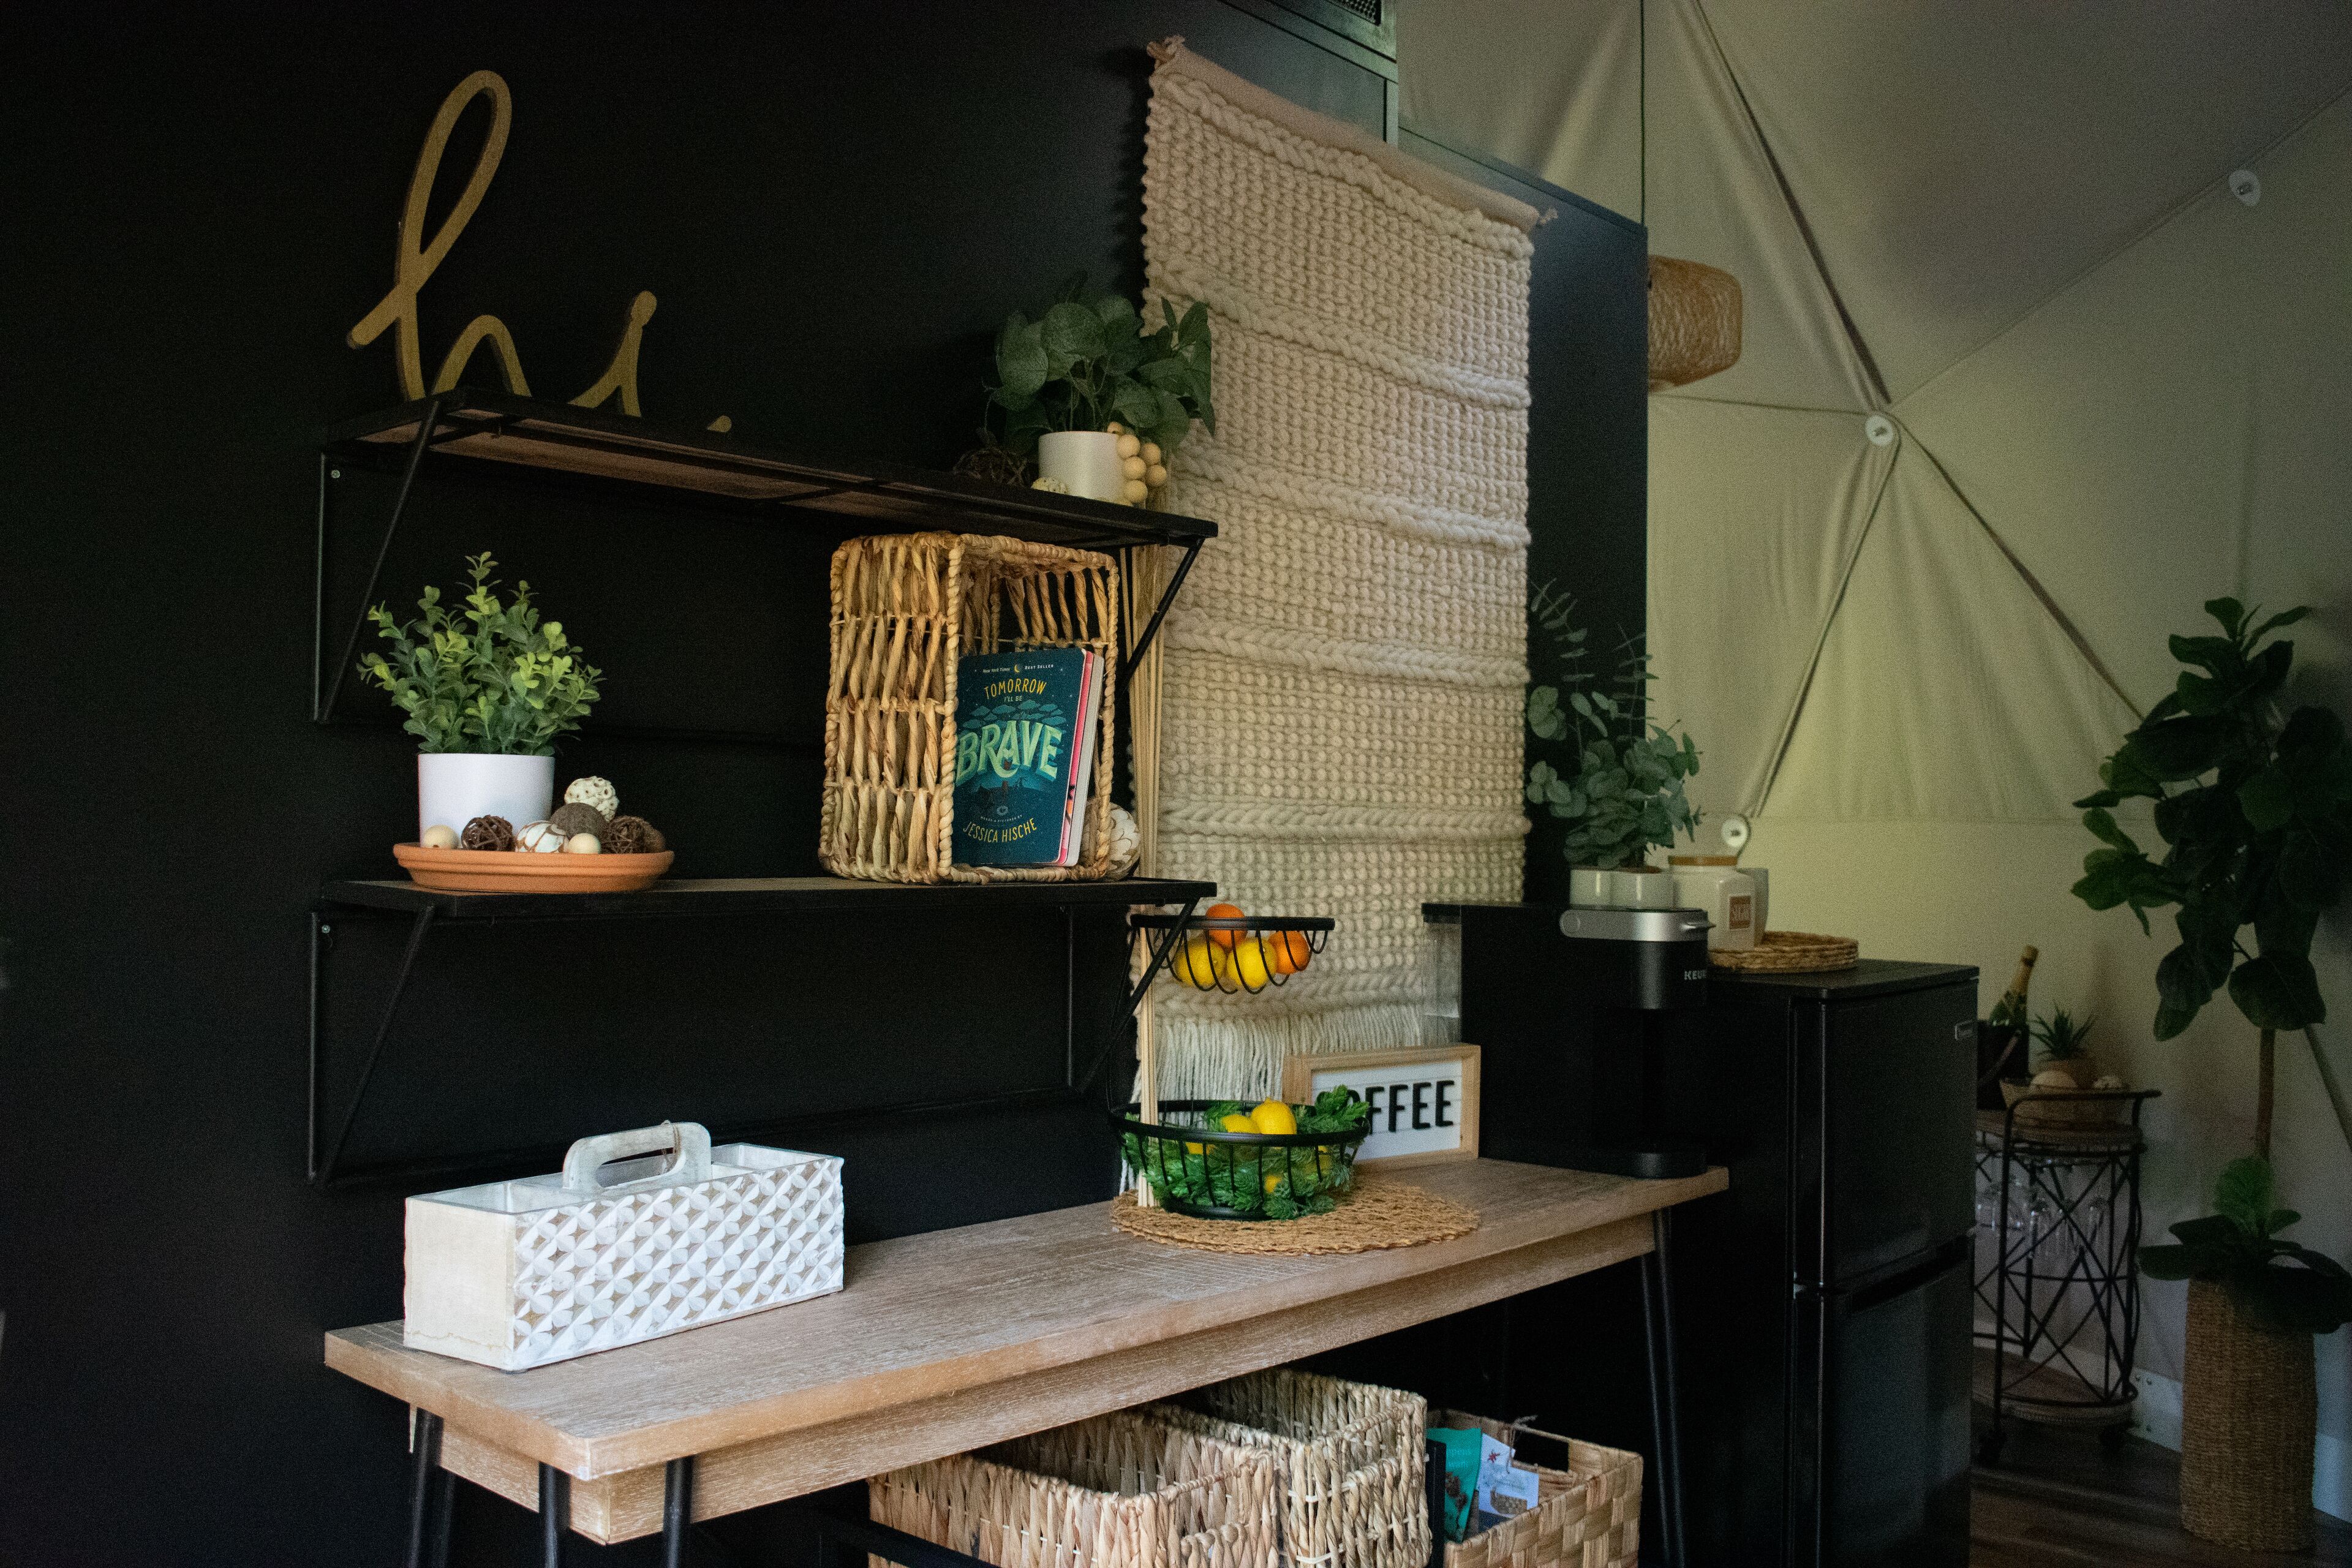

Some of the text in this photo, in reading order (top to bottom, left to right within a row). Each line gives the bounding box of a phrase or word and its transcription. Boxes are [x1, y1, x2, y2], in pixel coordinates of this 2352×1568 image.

[984, 678, 1047, 699] TOMORROW
[956, 720, 1062, 783] BRAVE
[963, 818, 1037, 843] JESSICA HISCHE
[1316, 1080, 1455, 1134] FFEE
